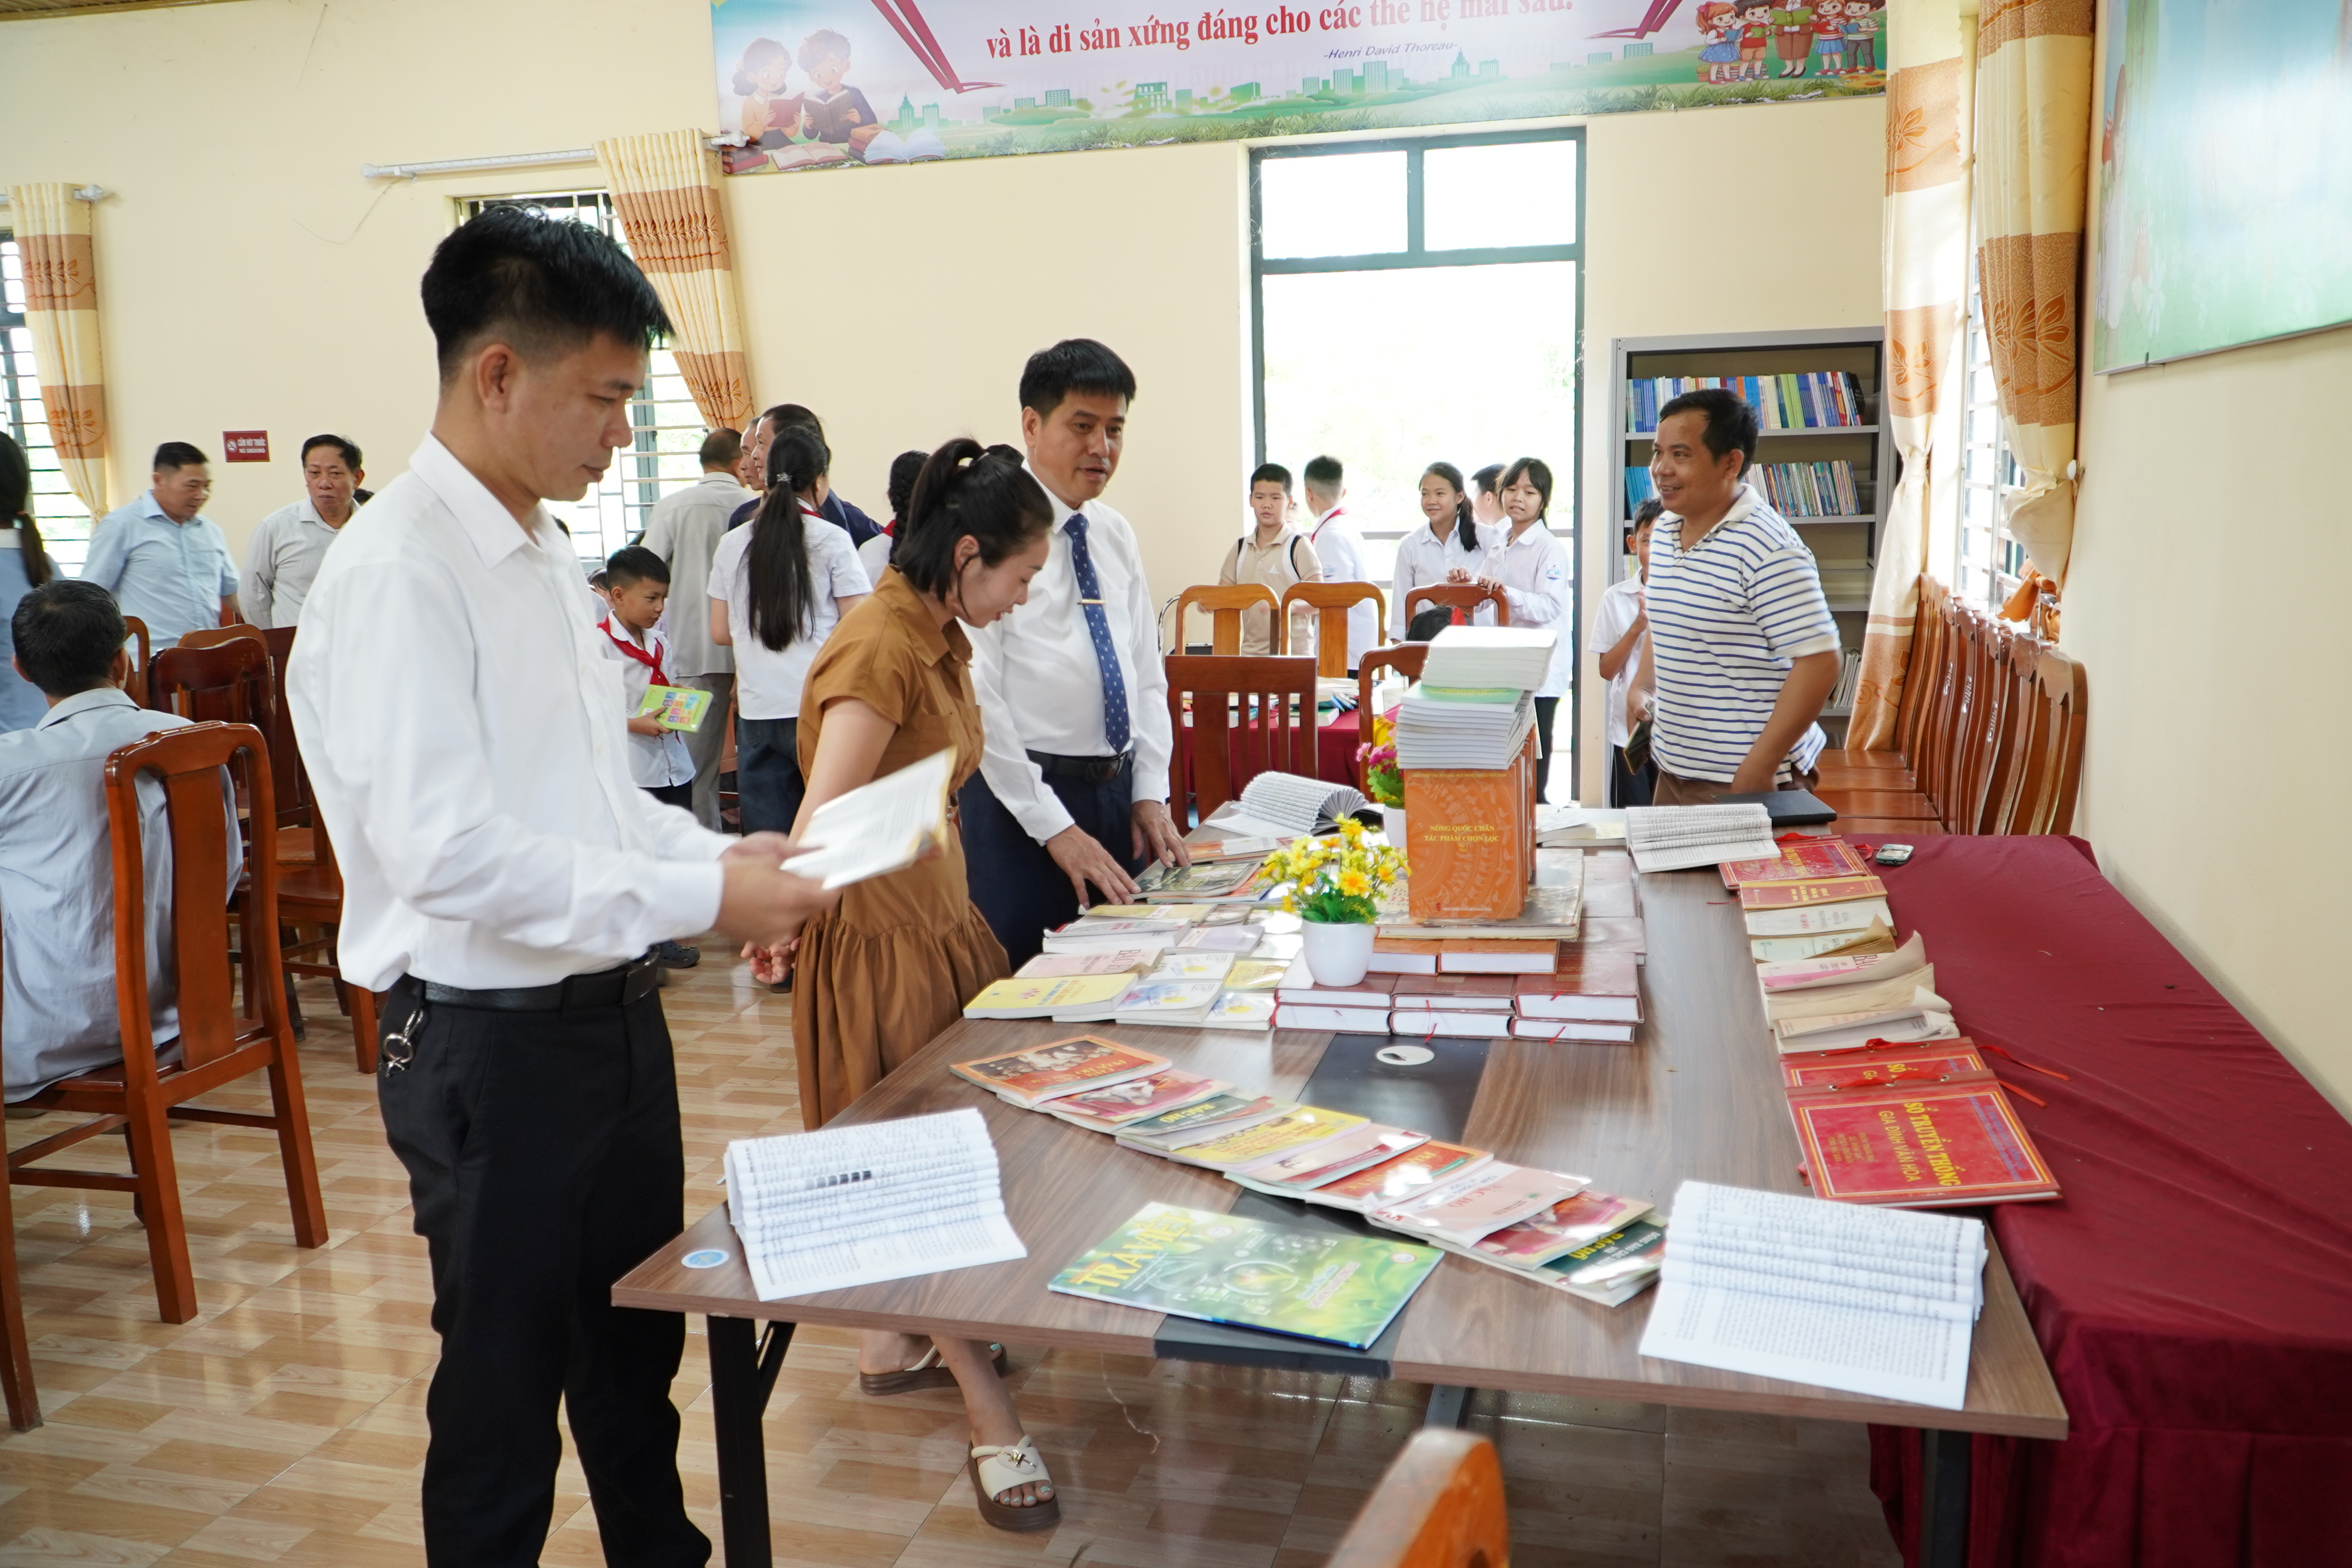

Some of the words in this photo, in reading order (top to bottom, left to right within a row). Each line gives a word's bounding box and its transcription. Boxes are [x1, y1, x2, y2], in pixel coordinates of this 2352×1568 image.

[986, 28, 1012, 59] và
[1018, 26, 1042, 56] là
[1049, 23, 1072, 54] di
[1079, 18, 1121, 51] sản
[1128, 14, 1190, 51] xứng
[1197, 8, 1258, 45] đáng
[1266, 5, 1311, 35] cho
[1319, 0, 1362, 30] các
[1365, 44, 1401, 56] David
[1904, 1102, 1939, 1114] SỔ
[1879, 1110, 1897, 1125] GIA
[1885, 1126, 1906, 1144] ĐÌNH
[1909, 1114, 1952, 1152] TRUYỀN
[1900, 1164, 1924, 1182] HÓA
[1927, 1153, 1966, 1187] THỐNG
